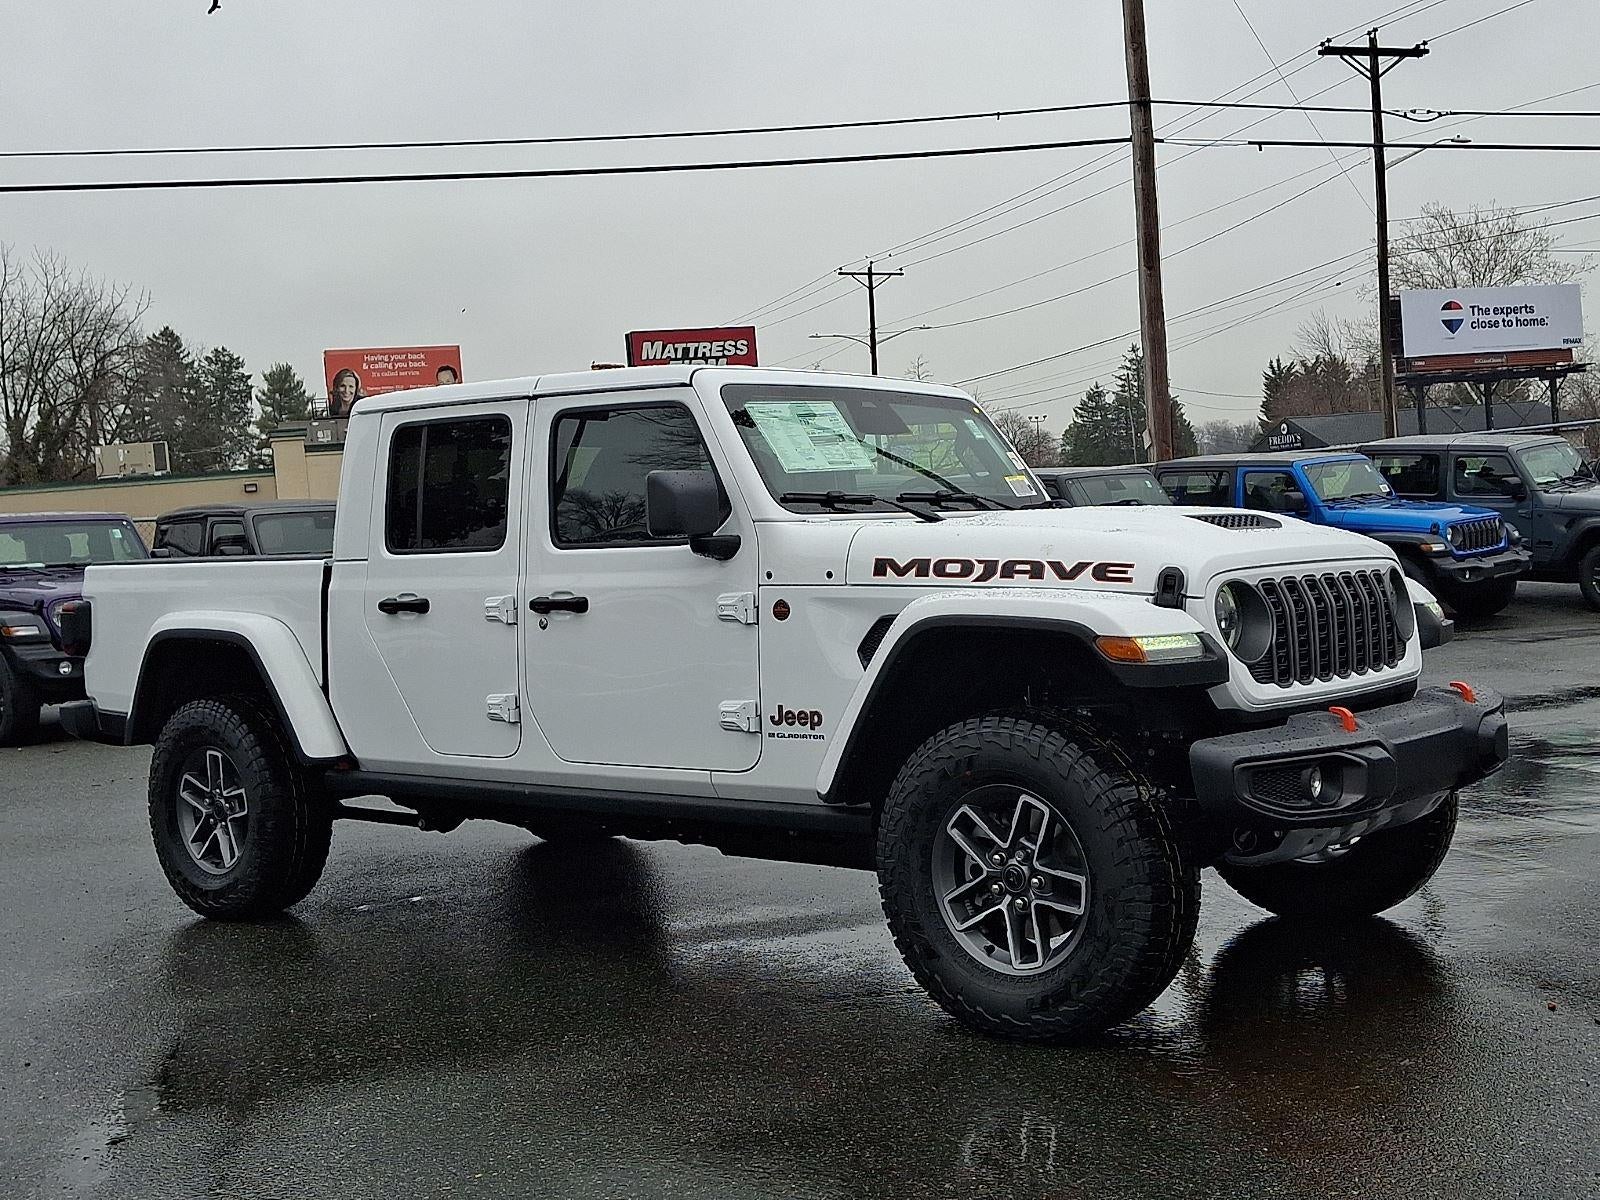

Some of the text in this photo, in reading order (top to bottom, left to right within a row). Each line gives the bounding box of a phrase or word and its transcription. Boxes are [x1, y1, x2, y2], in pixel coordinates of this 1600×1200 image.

[1469, 304, 1535, 318] The experts
[1470, 318, 1500, 330] close
[1502, 318, 1514, 328] to
[641, 339, 750, 361] MATTRESS
[364, 352, 426, 362] Having your back
[370, 361, 393, 370] calling
[394, 362, 408, 370] you
[408, 360, 428, 368] back.
[1268, 433, 1302, 446] FREDDY'S
[872, 557, 1136, 583] MOJAVE
[769, 704, 823, 731] Jeep
[776, 732, 825, 740] GLADIATOR
